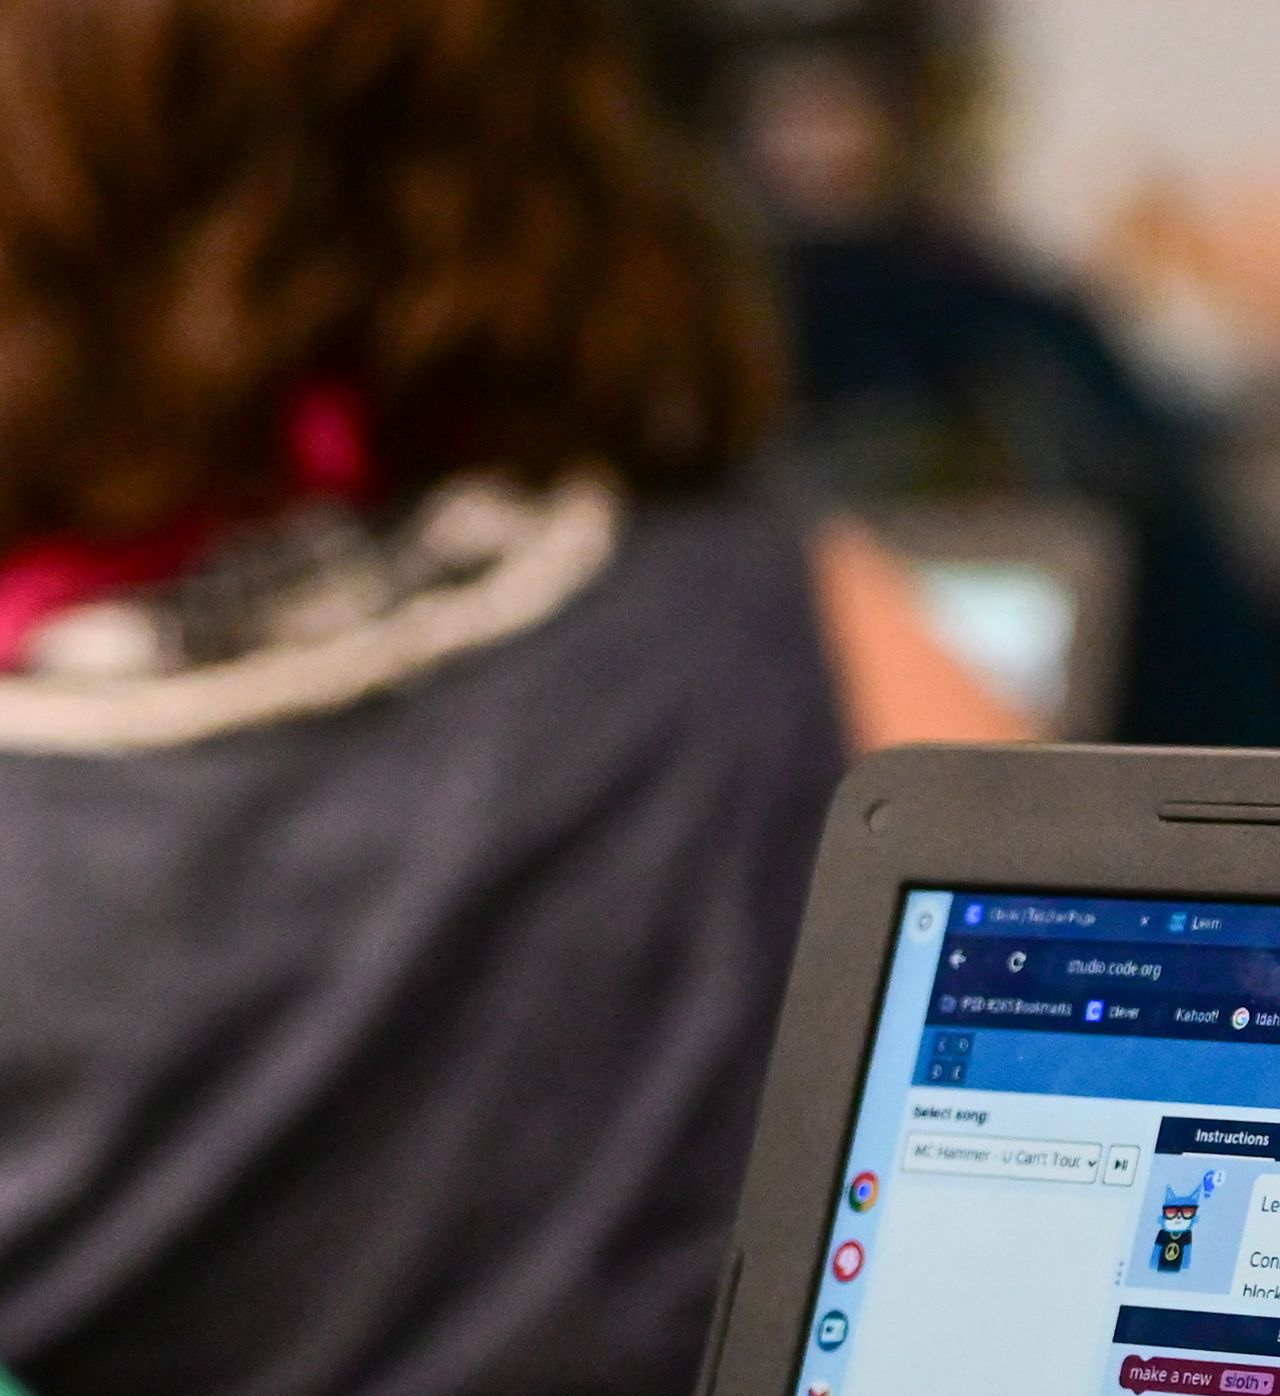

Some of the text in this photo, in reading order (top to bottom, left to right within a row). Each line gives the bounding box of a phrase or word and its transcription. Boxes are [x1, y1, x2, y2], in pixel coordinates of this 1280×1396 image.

[913, 1105, 951, 1121] Select
[1195, 1128, 1270, 1147] Instructions
[1128, 1364, 1169, 1383] make
[1170, 1370, 1180, 1384] a
[1181, 1369, 1213, 1387] new
[1223, 1372, 1260, 1392] sloth
